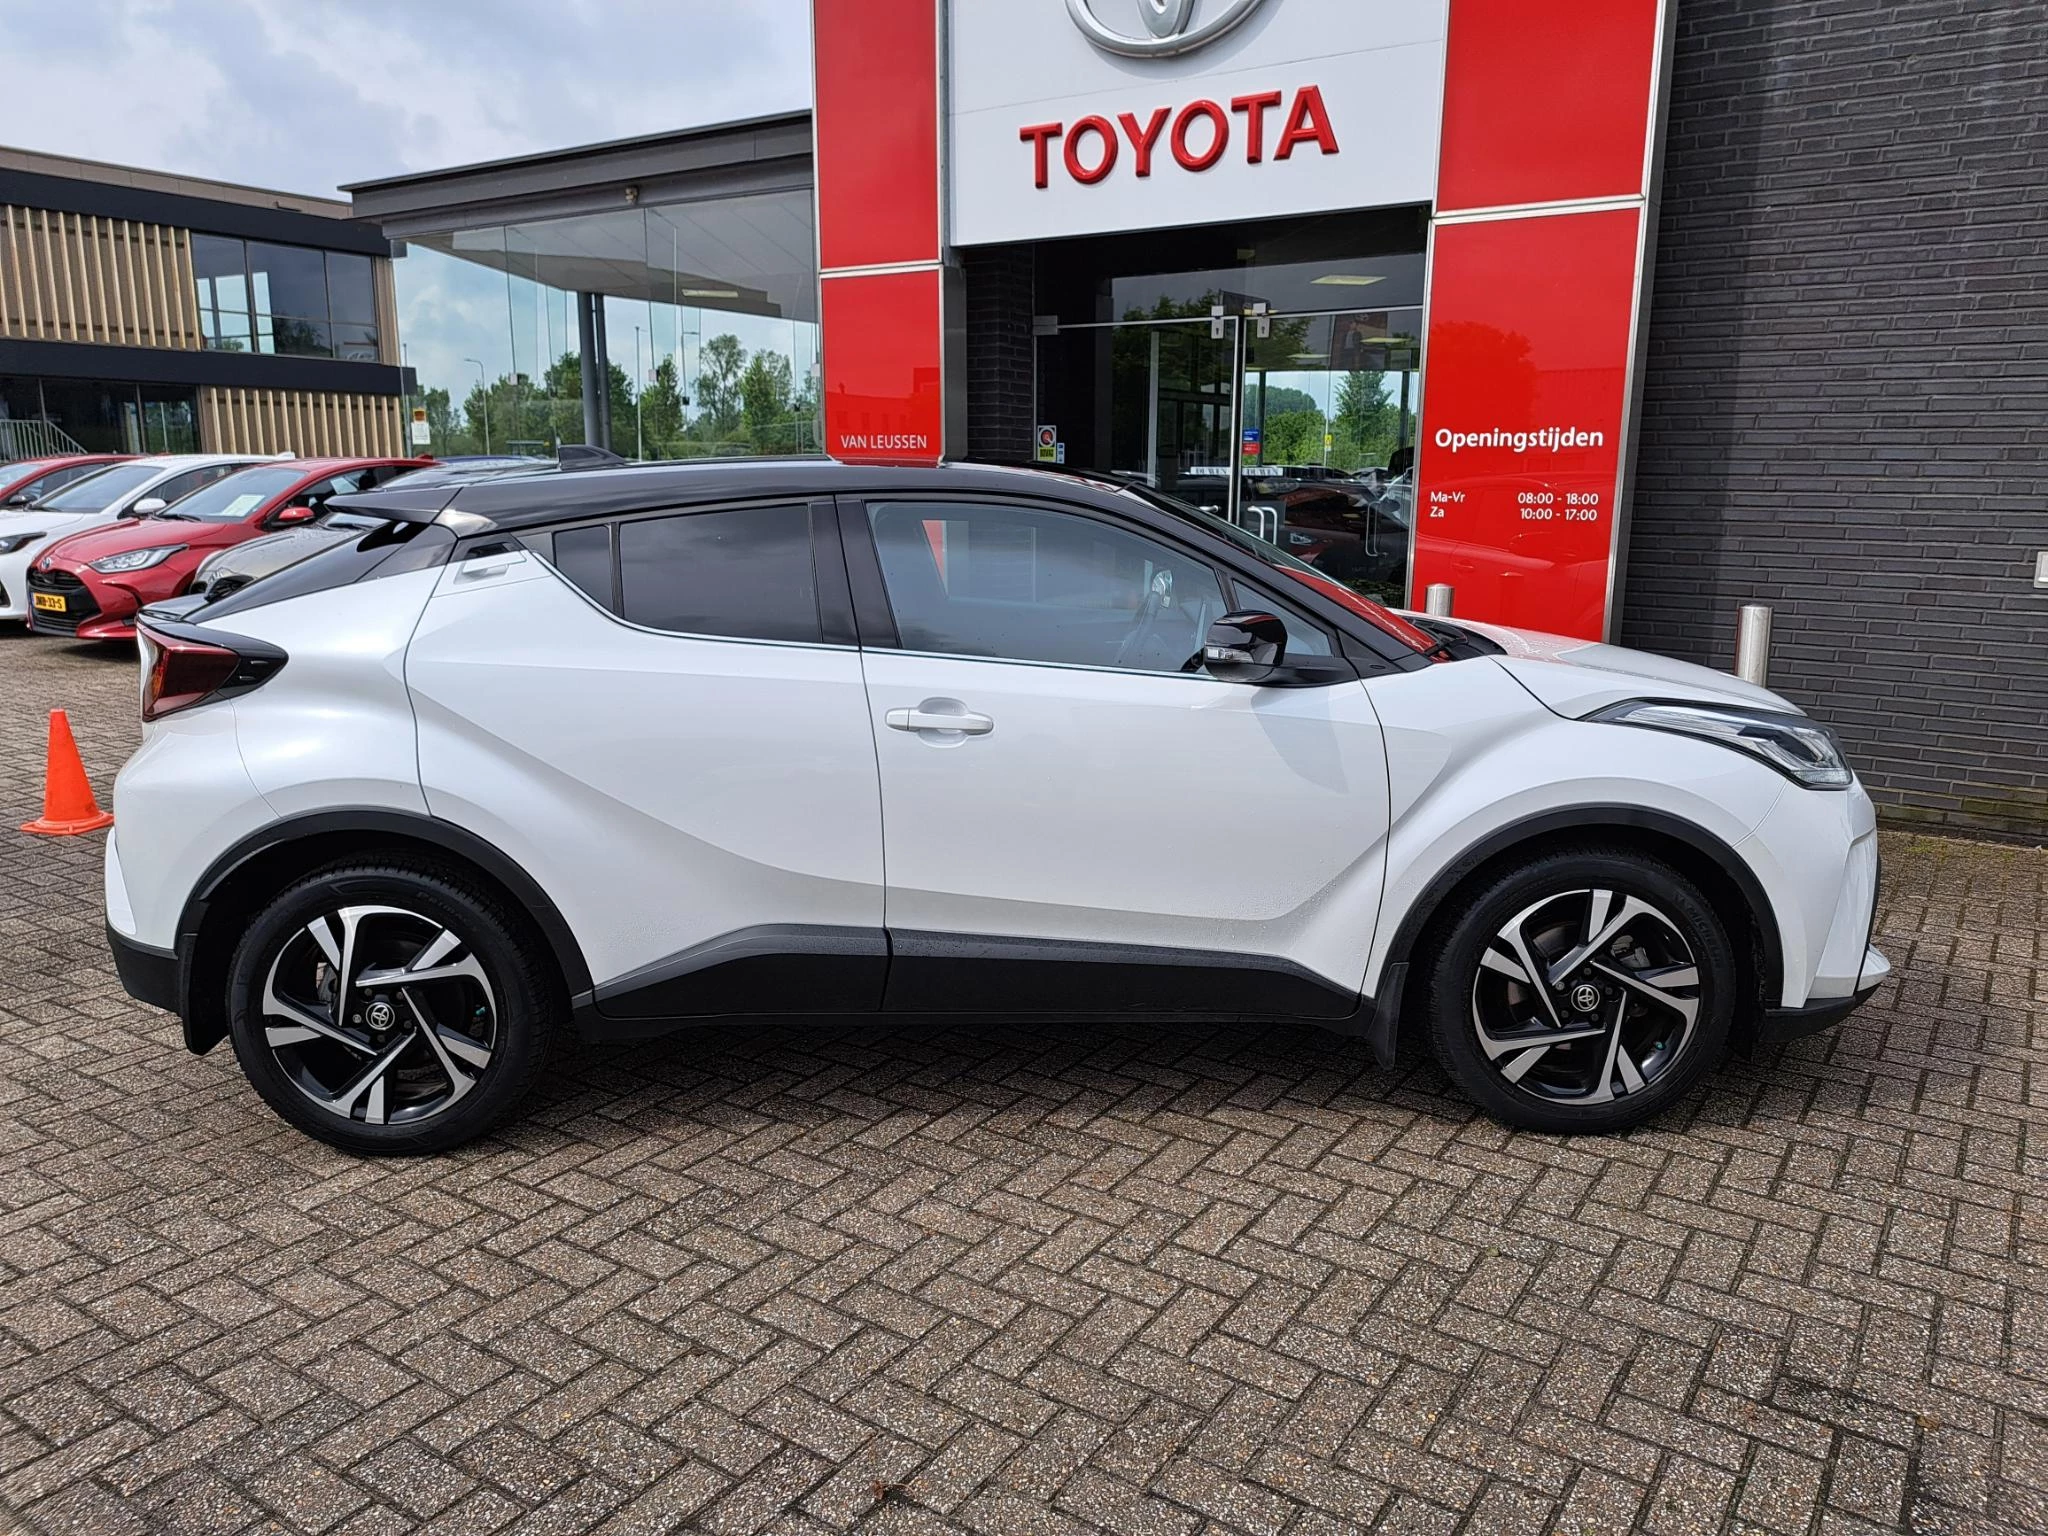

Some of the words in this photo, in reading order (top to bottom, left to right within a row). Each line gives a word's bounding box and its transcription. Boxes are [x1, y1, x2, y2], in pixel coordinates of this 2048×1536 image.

[1019, 84, 1340, 189] TOYOTA
[840, 434, 867, 449] VAN
[870, 434, 928, 449] LEUSSEN
[1435, 426, 1604, 453] Openingstijden
[1429, 491, 1466, 503] Ma-Vr
[1517, 492, 1554, 505] 08:00
[1565, 493, 1599, 506] 18:00
[1429, 505, 1445, 518] Za
[1520, 507, 1553, 520] 10:00
[1564, 508, 1598, 521] 17:00
